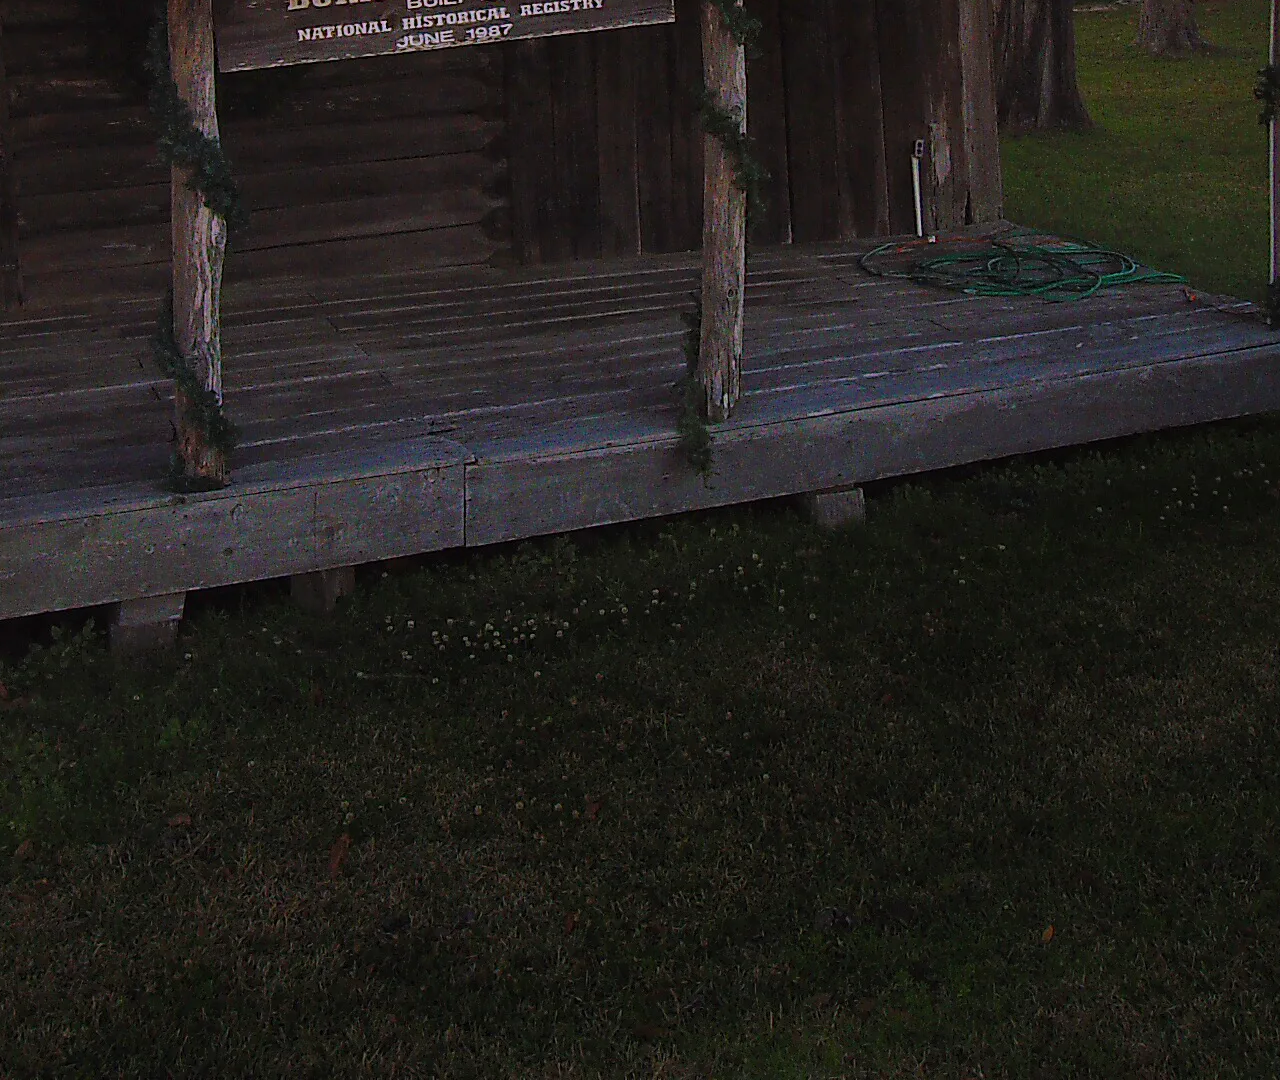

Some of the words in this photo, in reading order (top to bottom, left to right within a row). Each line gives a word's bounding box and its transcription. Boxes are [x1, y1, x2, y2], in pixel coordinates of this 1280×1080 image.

[297, 20, 392, 42] NATIONAL
[401, 6, 511, 30] HISTORICAL
[396, 30, 456, 49] JUNE
[465, 23, 514, 40] 1987
